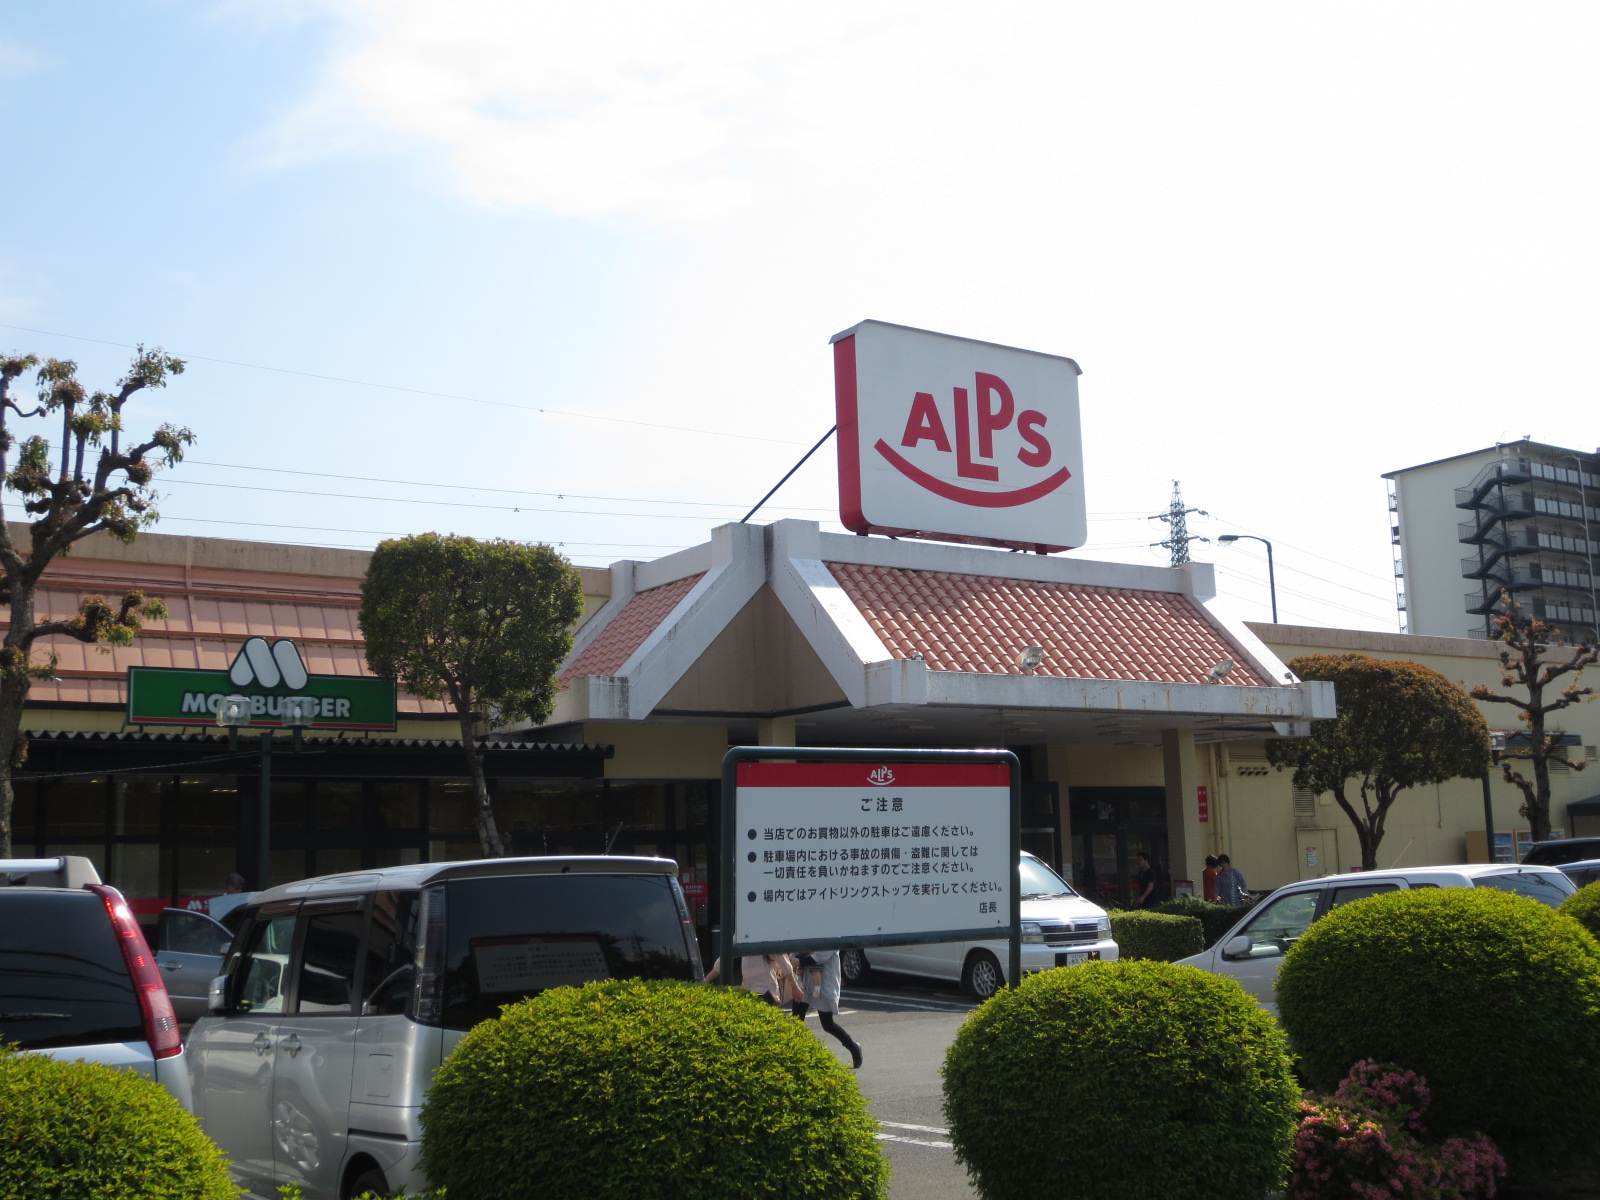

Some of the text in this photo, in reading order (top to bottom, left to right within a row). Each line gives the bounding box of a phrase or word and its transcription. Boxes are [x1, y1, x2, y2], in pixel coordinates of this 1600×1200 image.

[901, 371, 1052, 482] ALPS
[870, 765, 893, 782] ALPS
[861, 797, 903, 812] ご注意
[763, 825, 974, 841] 当店でのお買物以外の駐車はご遠慮ください。
[763, 846, 978, 863] 駐車場内における事故の損傷・盗難に関しては
[763, 862, 974, 879] 一切責任を負いかねますのでご注意ください。
[763, 881, 1002, 903] 場内ではアイドリングストップを実行してください。
[979, 901, 997, 914] 店長
